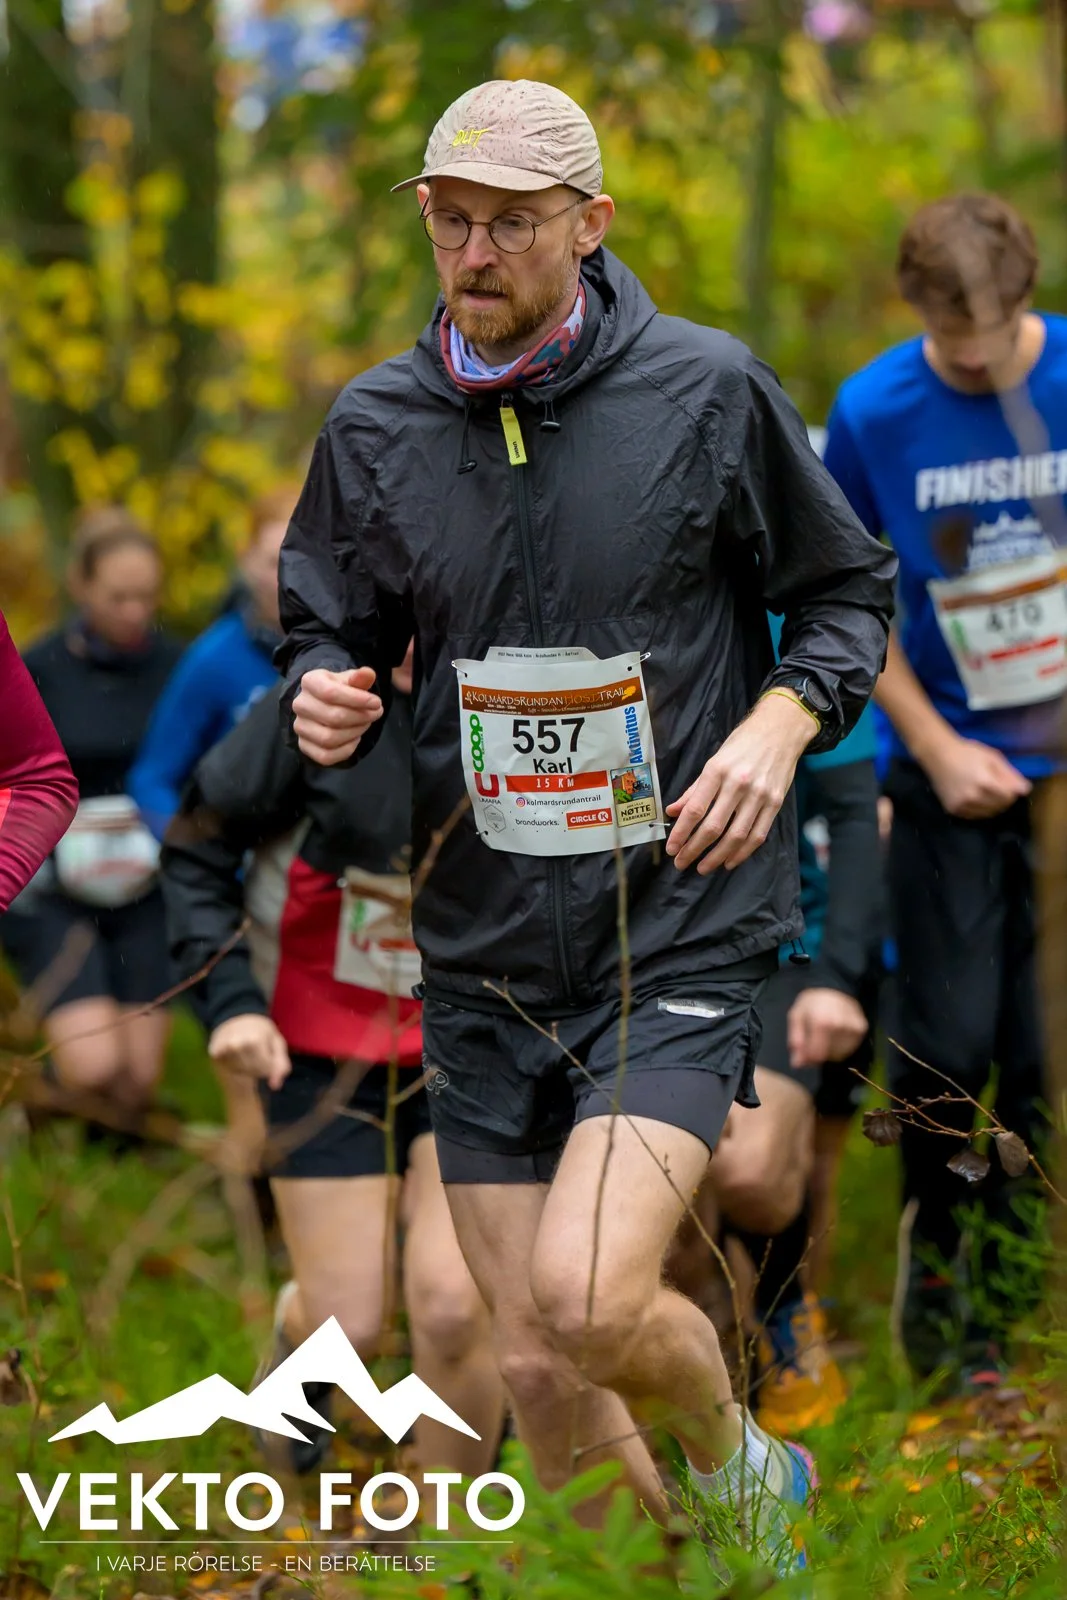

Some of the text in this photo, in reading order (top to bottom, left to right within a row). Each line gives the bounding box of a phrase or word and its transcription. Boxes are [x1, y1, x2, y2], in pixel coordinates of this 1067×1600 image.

[512, 717, 585, 755] 557
[624, 706, 643, 764] Aktivitus
[533, 757, 573, 774] Karl
[536, 777, 575, 788] 15 KM
[620, 804, 652, 817] NØTTE
[570, 814, 597, 824] CIRCLE
